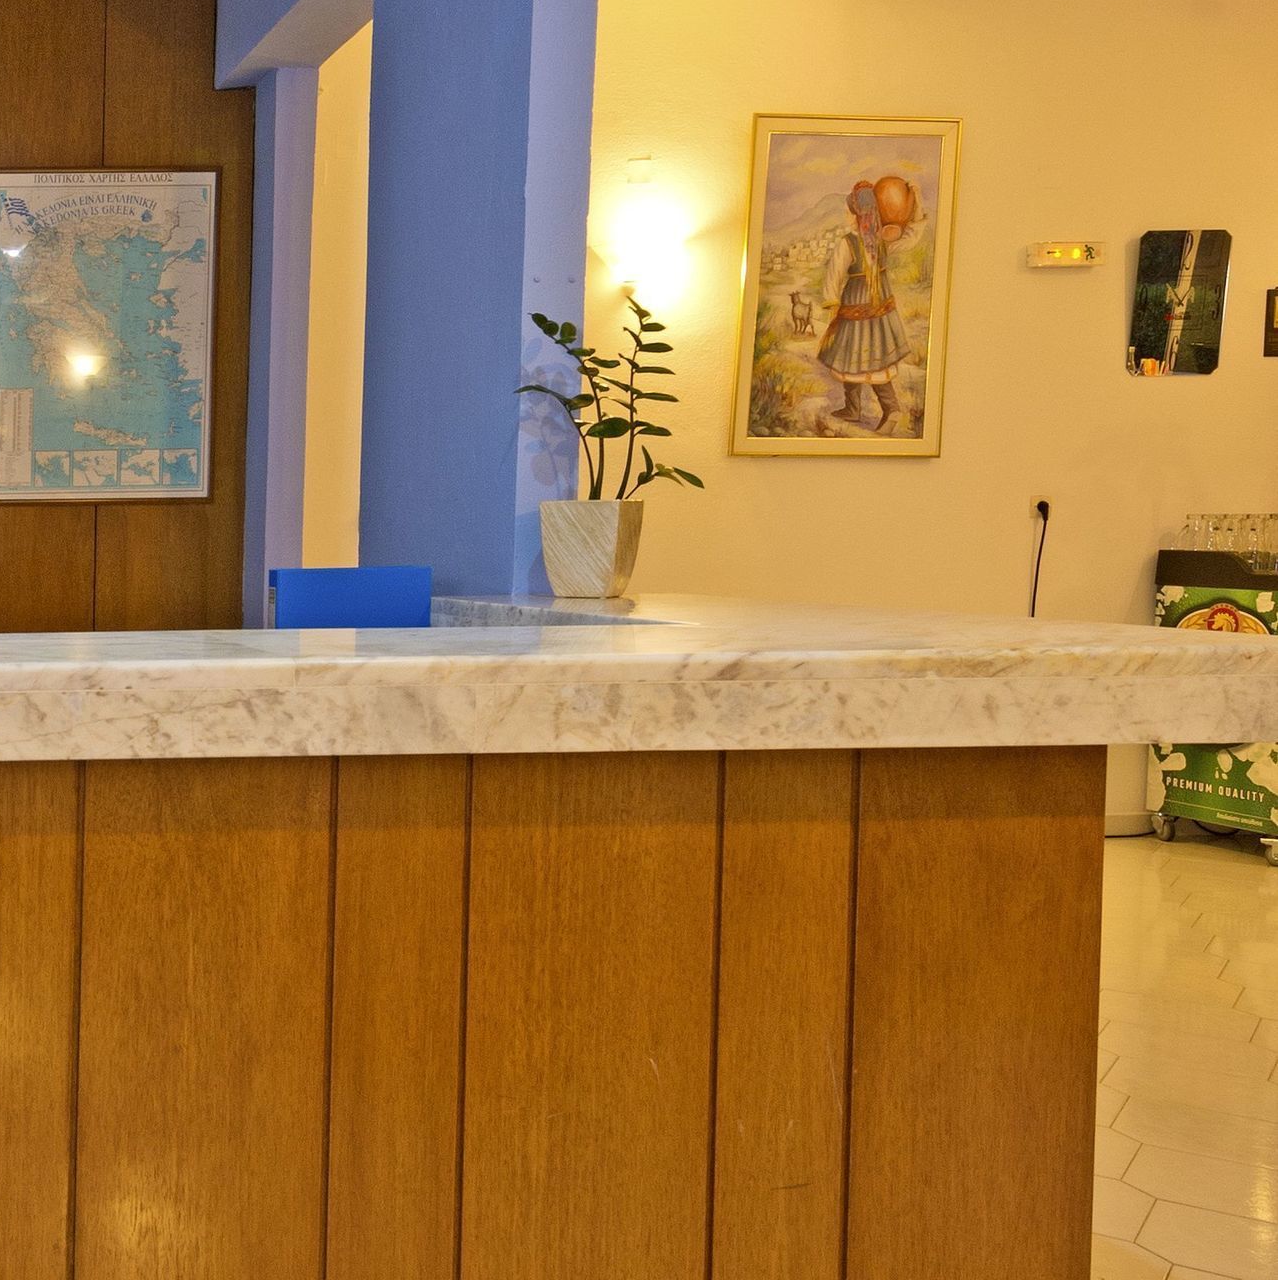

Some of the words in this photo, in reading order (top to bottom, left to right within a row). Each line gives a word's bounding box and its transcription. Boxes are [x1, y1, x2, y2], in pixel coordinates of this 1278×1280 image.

[33, 173, 85, 184] ΠΟΛΙΤΙΚΟΣ
[88, 173, 126, 183] ΧΑΡΤΗΣ
[129, 173, 173, 183] ΕΛΛΑΔΟΣ
[79, 194, 105, 206] ΕΙΝΑΙ
[107, 194, 158, 211] ΕΛΛΗΝΙΚΗ
[90, 206, 100, 216] IS
[102, 205, 135, 216] GREEK
[1166, 776, 1213, 793] PREMIUM
[1218, 786, 1265, 802] QUALITY
